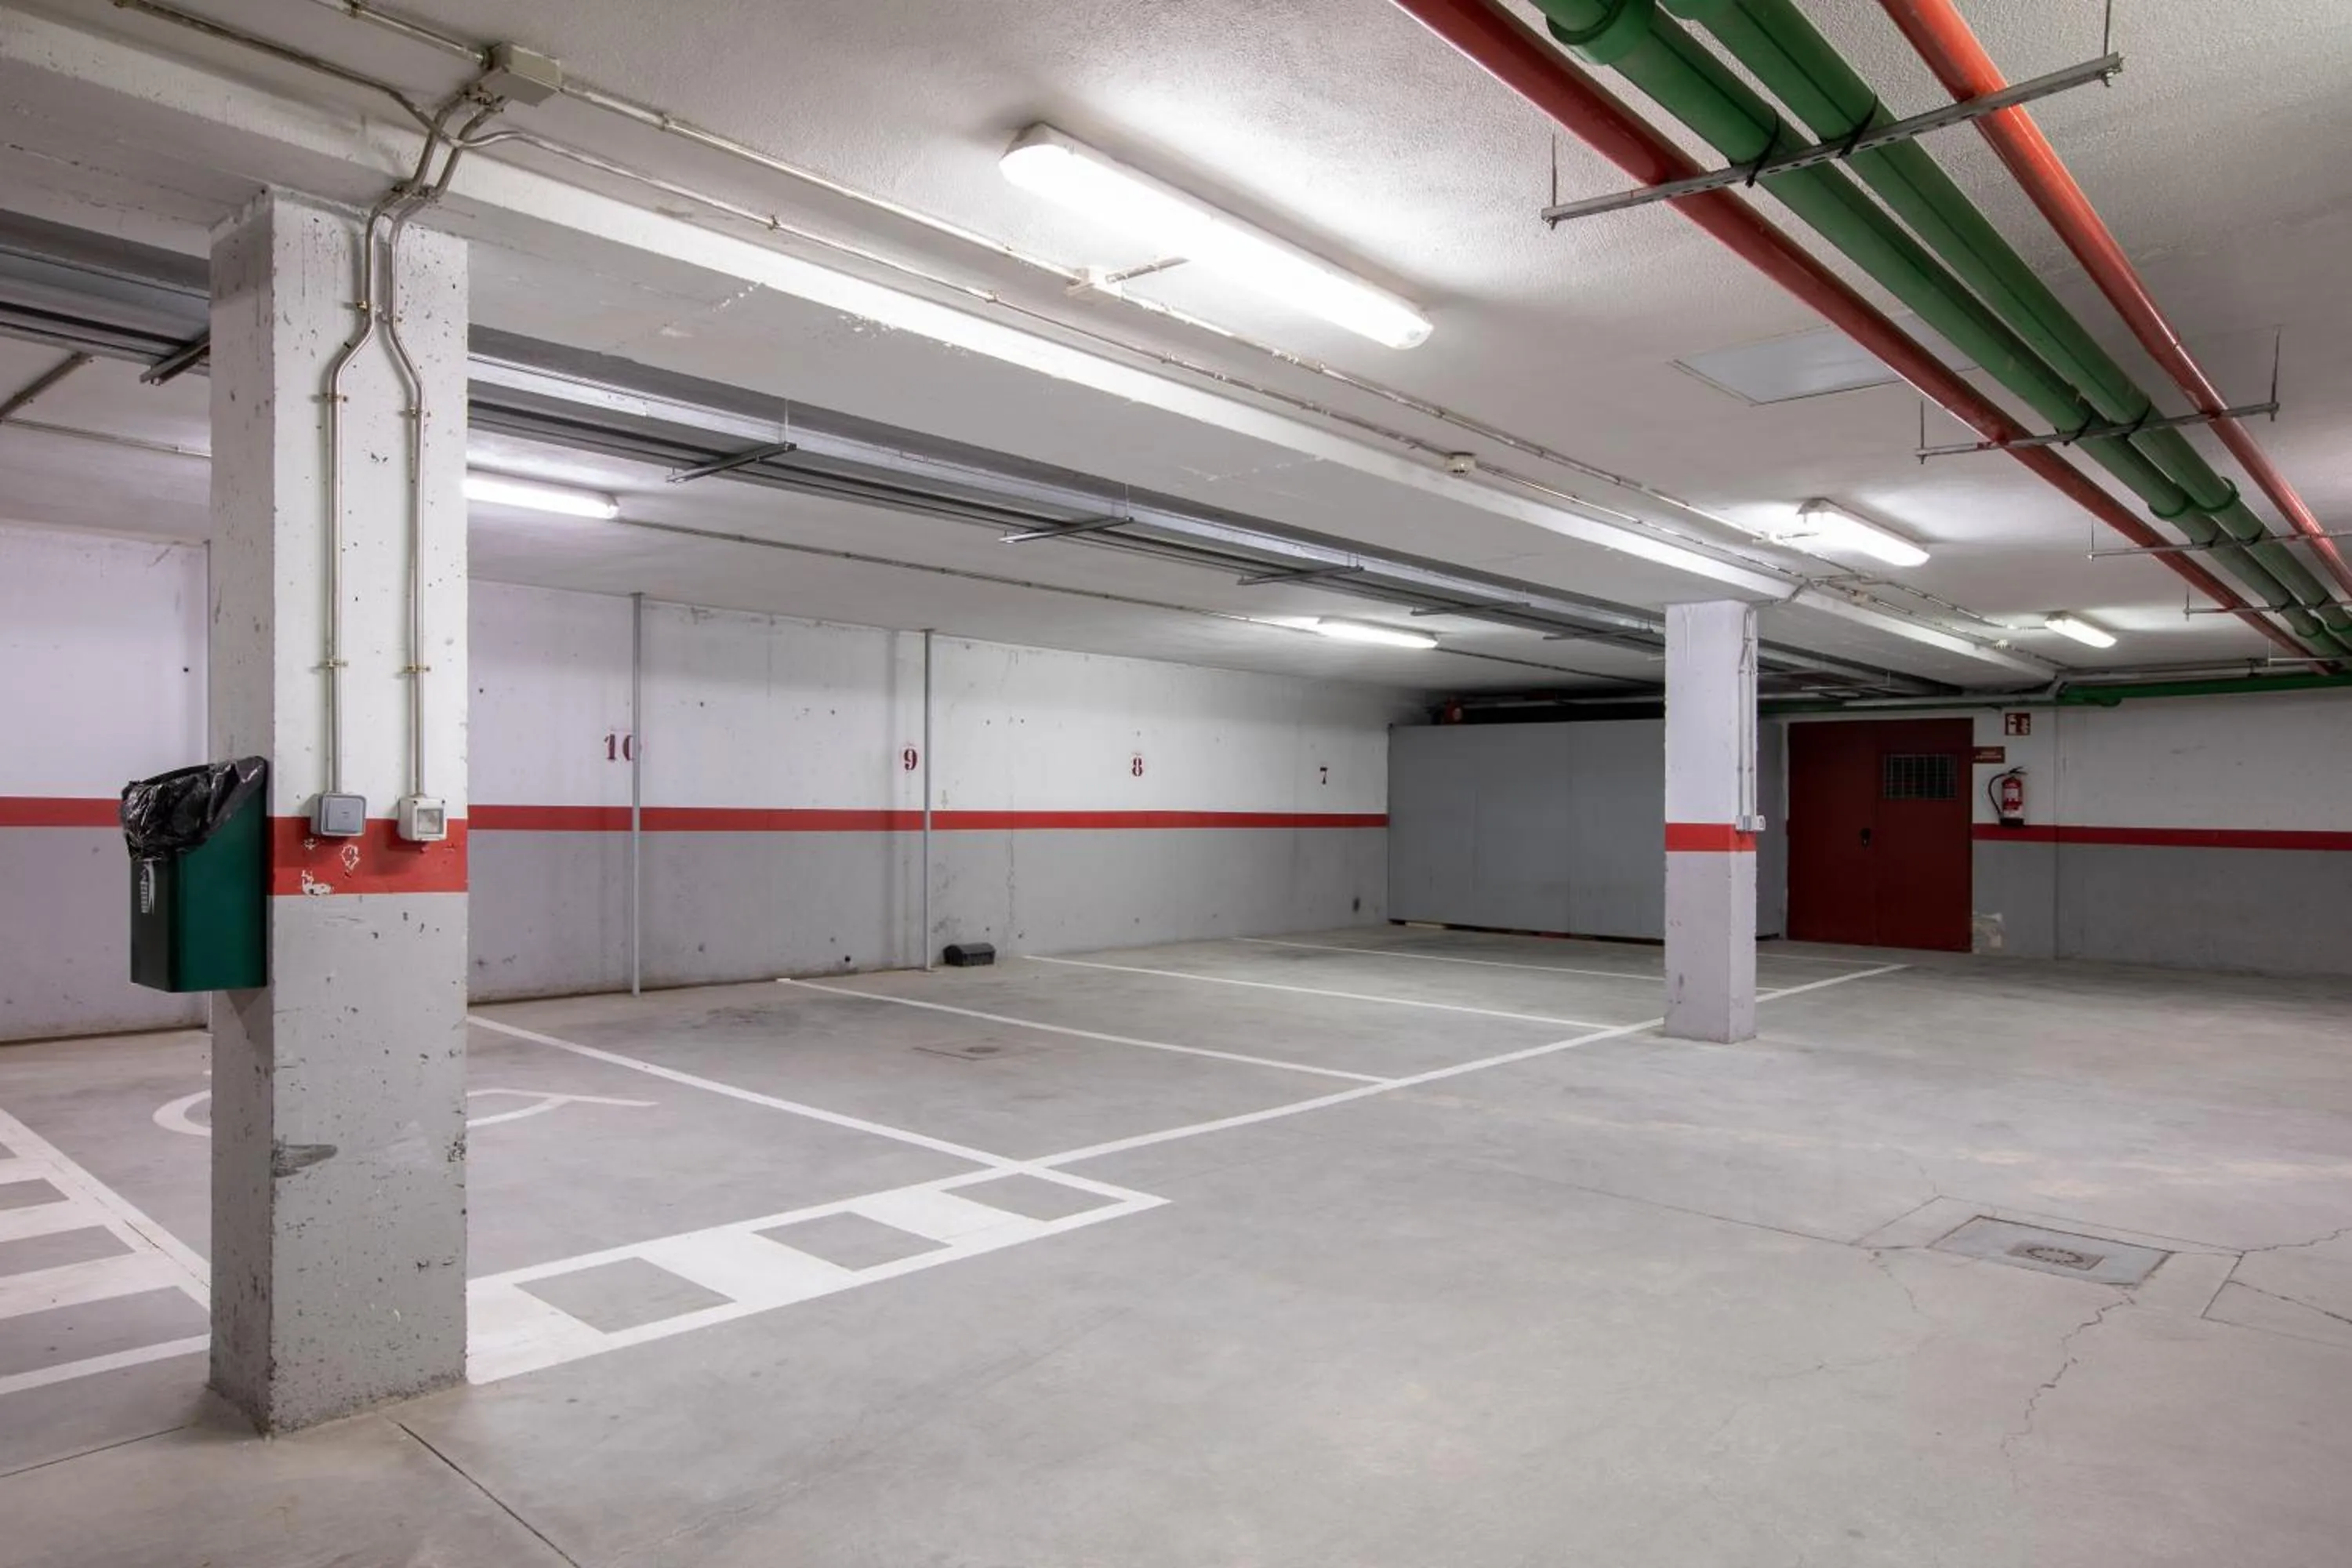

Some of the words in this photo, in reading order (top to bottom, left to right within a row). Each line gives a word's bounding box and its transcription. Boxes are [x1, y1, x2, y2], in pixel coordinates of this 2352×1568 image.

[903, 749, 918, 771] 9
[1131, 757, 1143, 777] 8
[1319, 766, 1328, 785] 7
